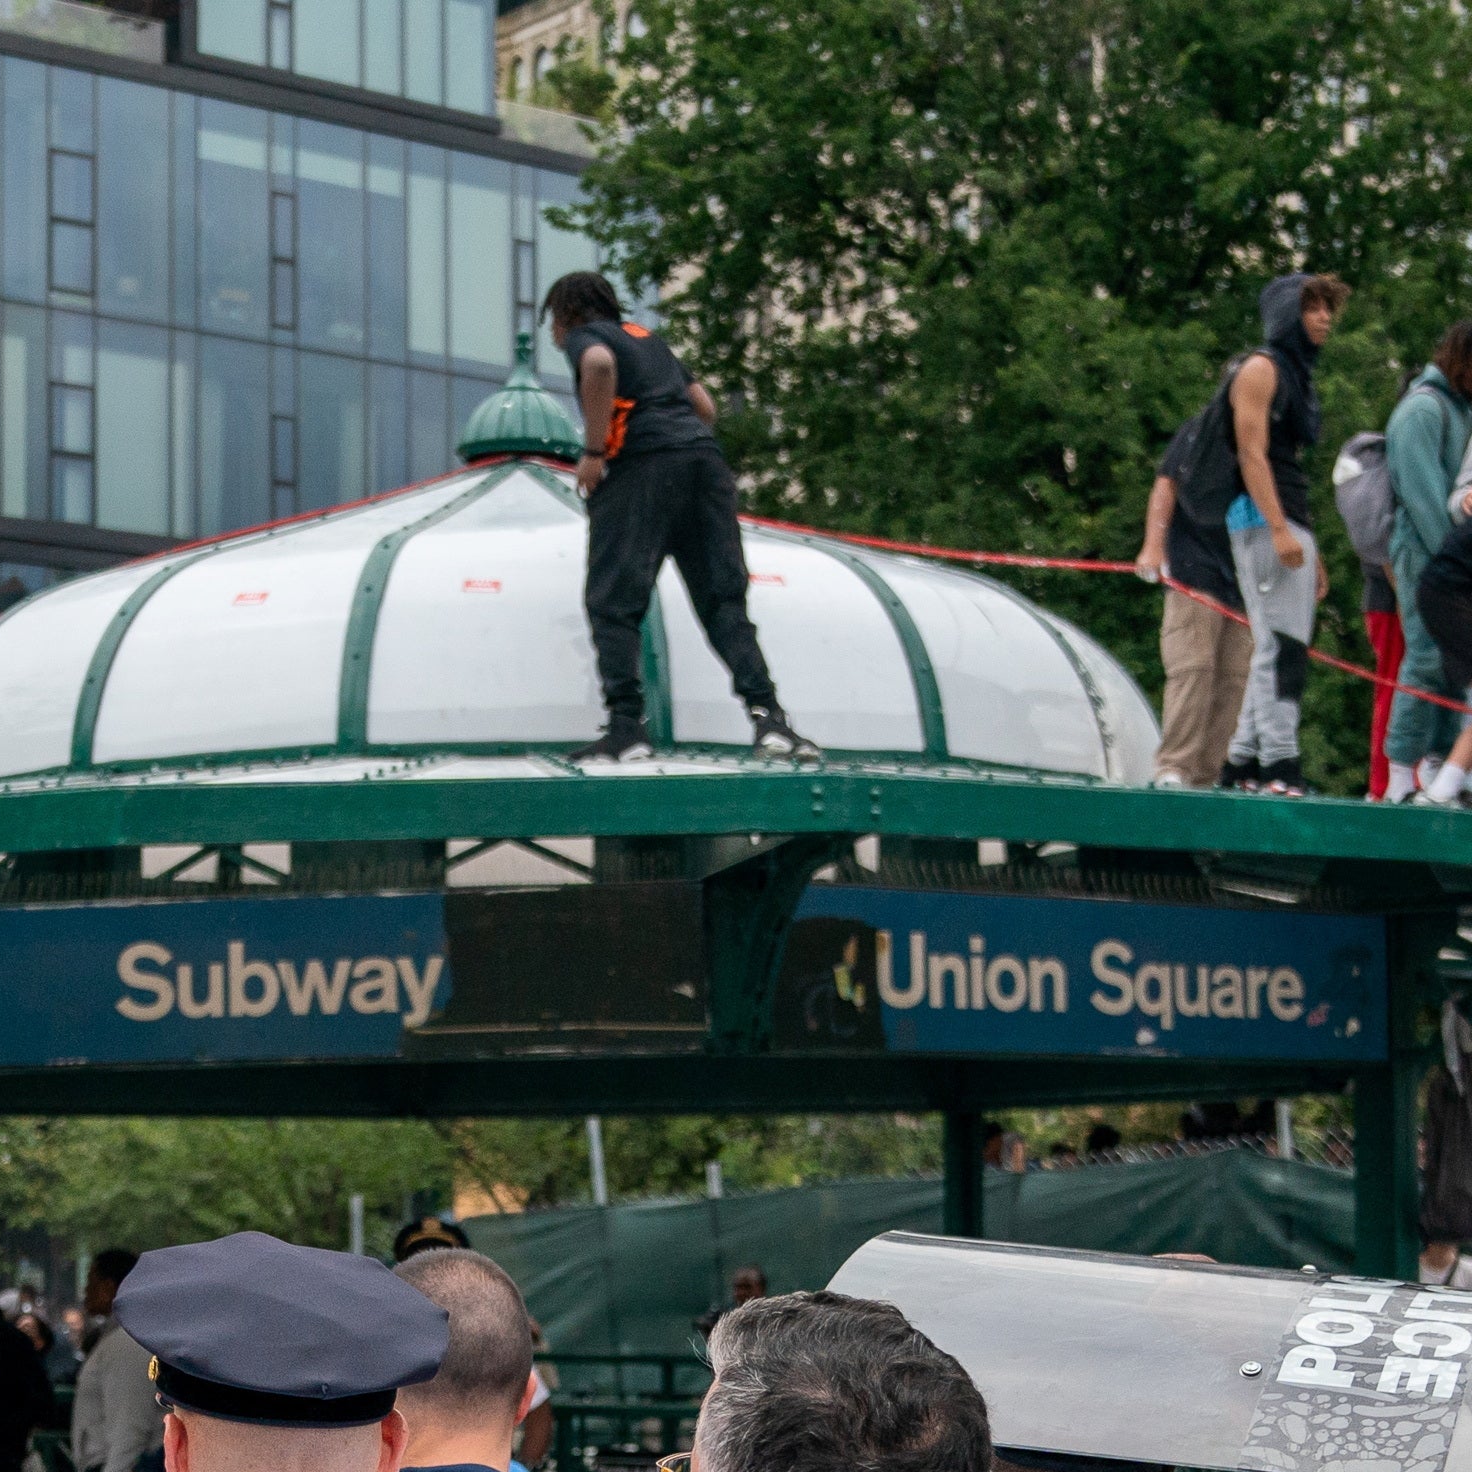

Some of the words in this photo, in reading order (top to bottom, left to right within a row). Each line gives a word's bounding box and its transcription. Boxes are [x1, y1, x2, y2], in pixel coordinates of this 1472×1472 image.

[114, 940, 443, 1027] Subway
[875, 930, 1067, 1013] Union
[1090, 939, 1303, 1030] Square
